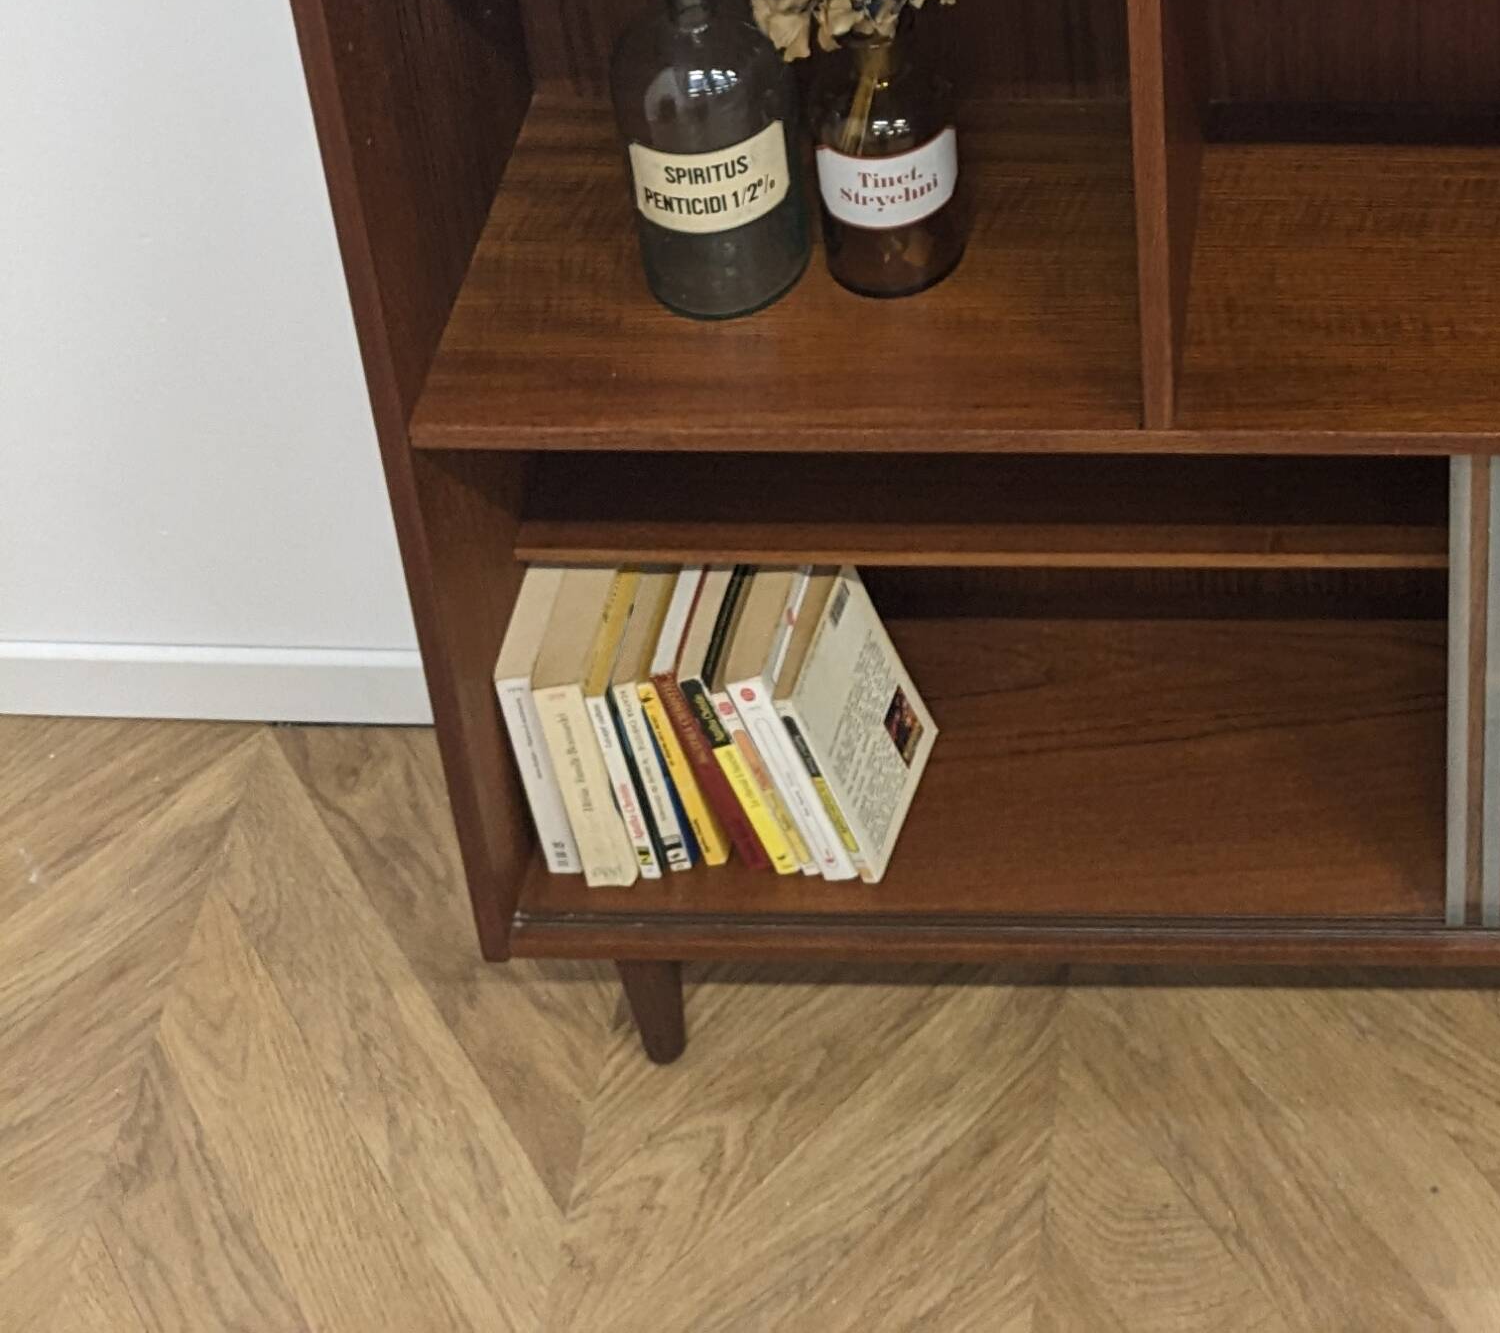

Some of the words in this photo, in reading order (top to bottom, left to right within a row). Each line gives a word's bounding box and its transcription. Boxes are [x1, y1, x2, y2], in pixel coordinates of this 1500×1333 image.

[664, 155, 749, 185] SPIRITUS
[643, 186, 728, 215] PENTICIDI
[840, 173, 940, 212] Strychni
